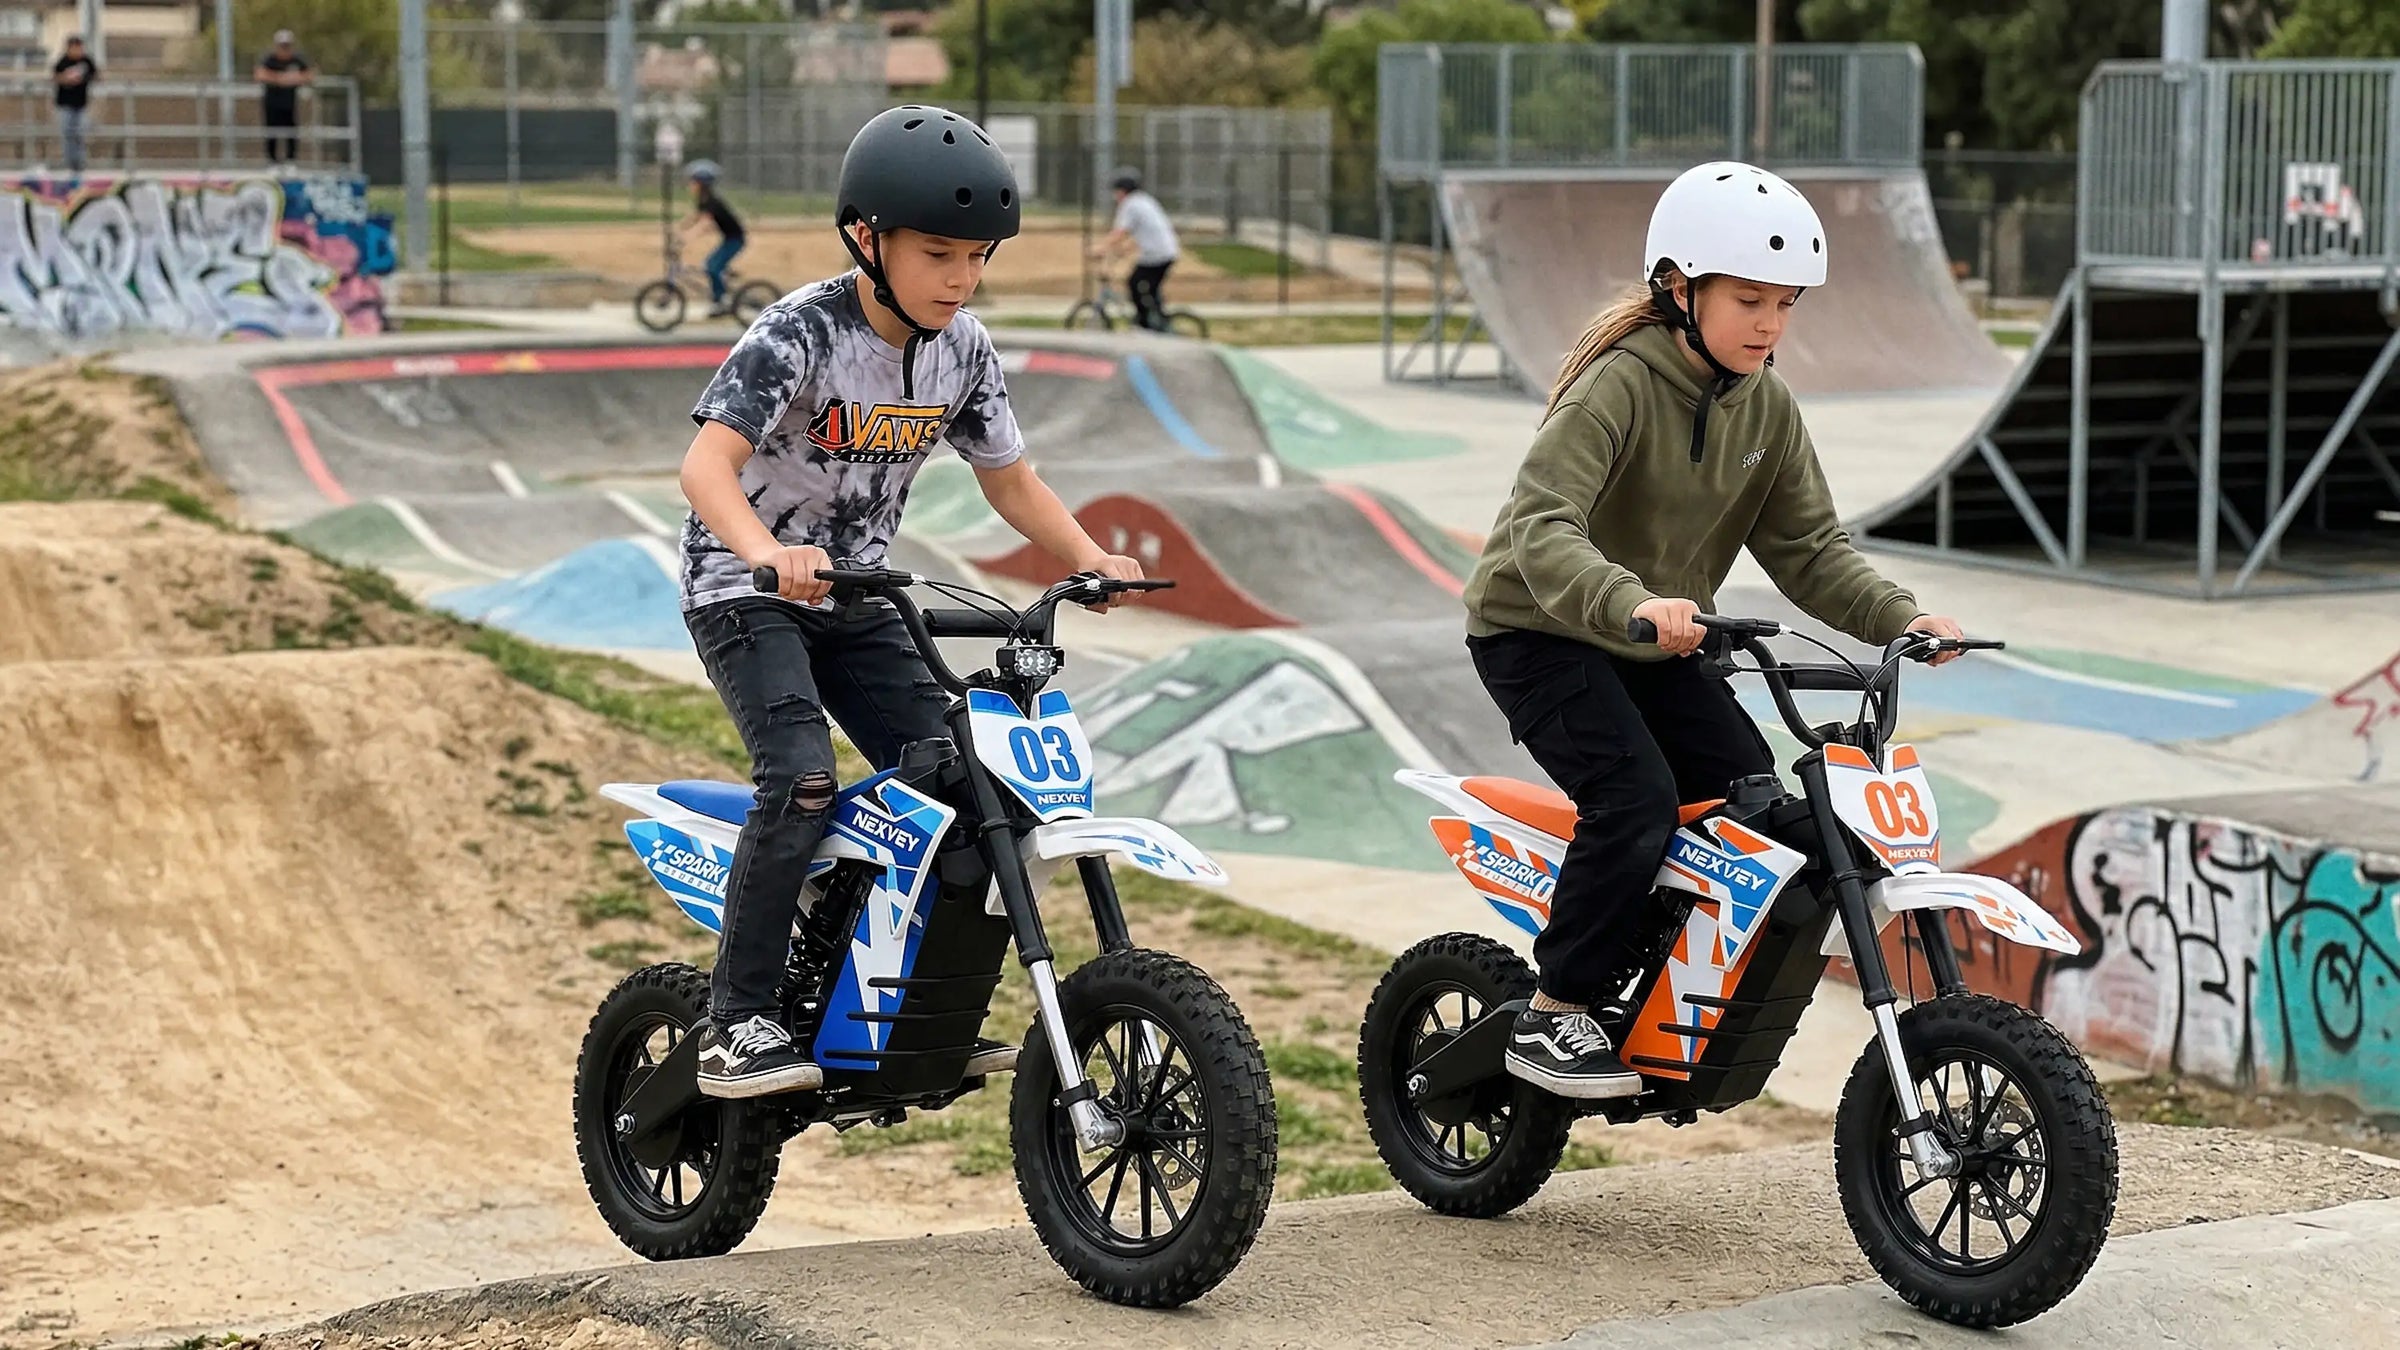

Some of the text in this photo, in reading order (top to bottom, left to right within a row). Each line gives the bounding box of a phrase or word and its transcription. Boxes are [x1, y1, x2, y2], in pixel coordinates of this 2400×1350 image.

[1009, 726, 1081, 782] 03
[1037, 793, 1087, 806] NEXVEY
[1864, 781, 1929, 838] 03
[852, 810, 920, 852] NEXVEY
[669, 849, 728, 883] SPARK
[1481, 850, 1542, 887] SPARK
[1677, 844, 1767, 892] NEXVEY
